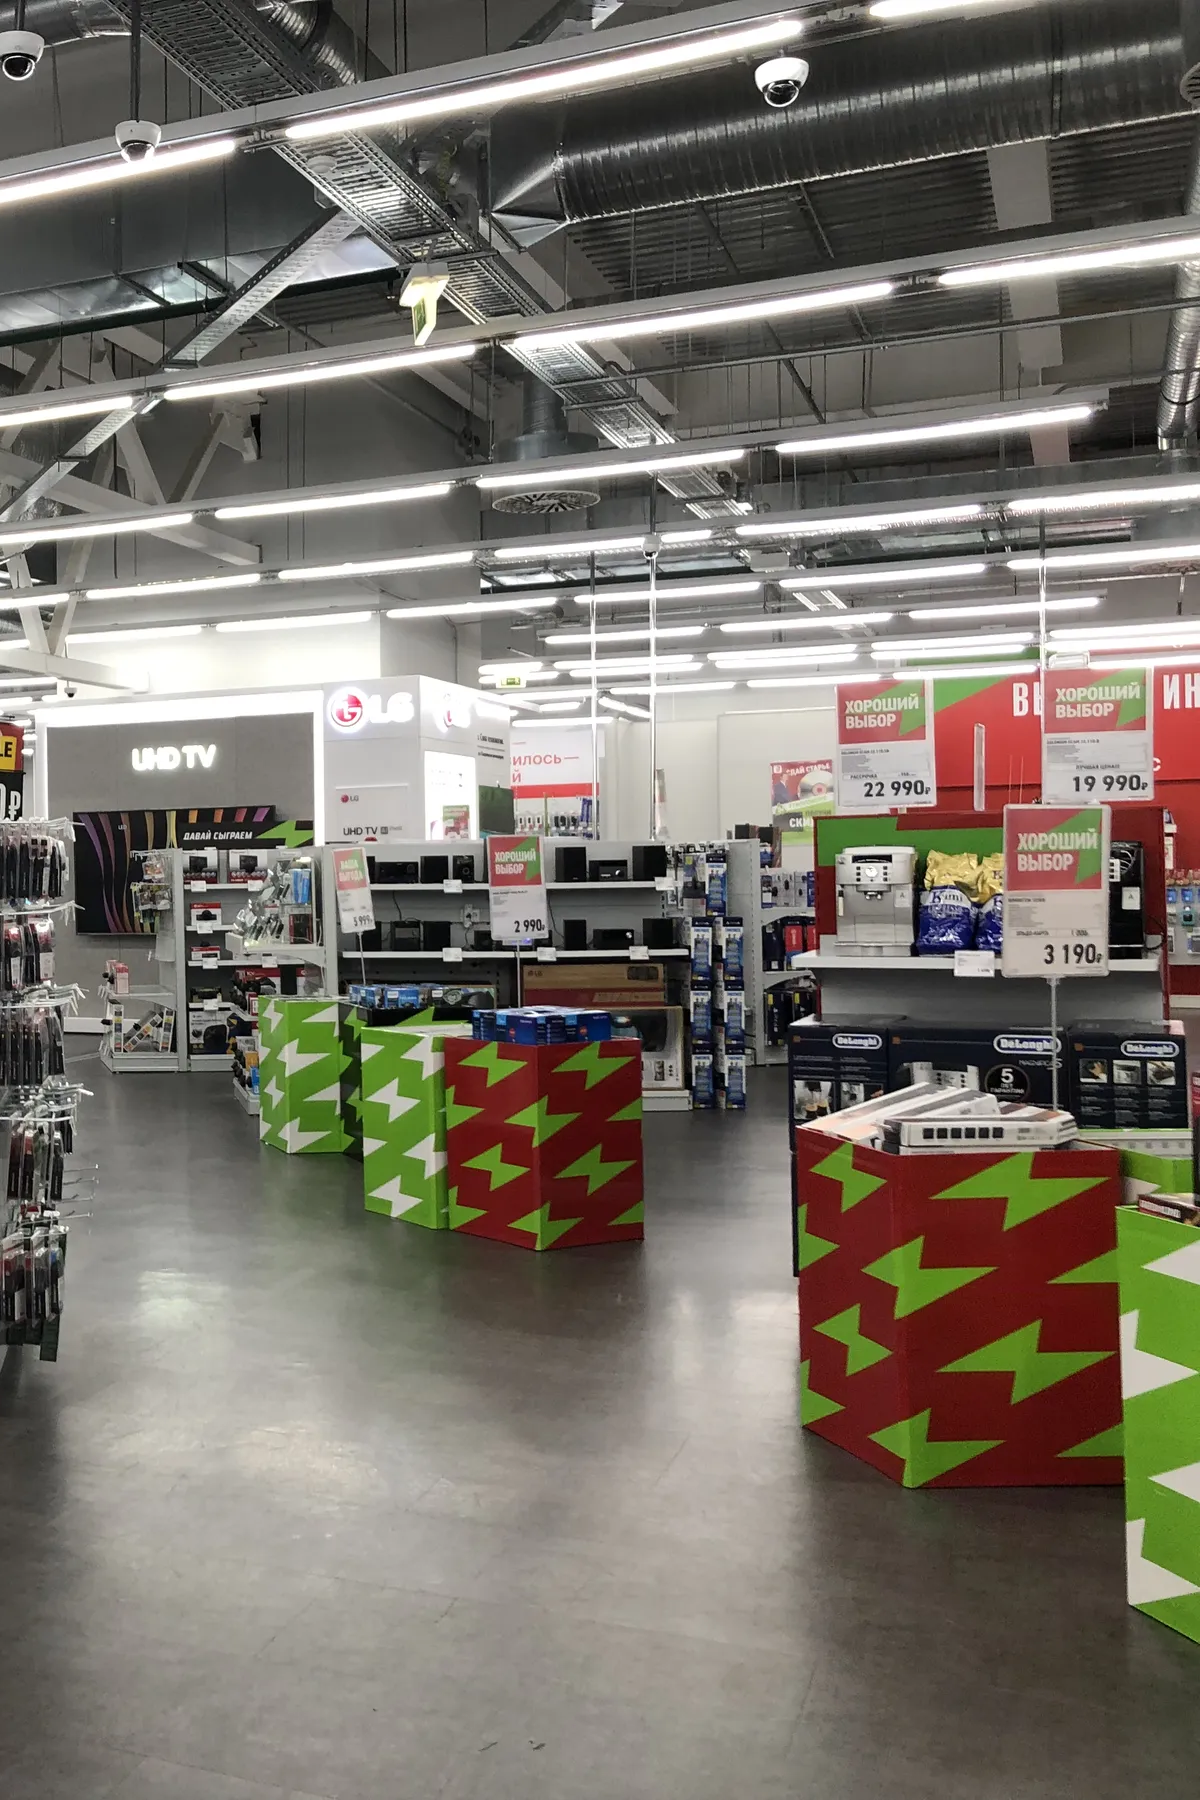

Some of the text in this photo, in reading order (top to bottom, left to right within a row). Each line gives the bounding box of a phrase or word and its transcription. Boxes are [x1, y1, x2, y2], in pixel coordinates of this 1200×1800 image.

[1055, 682, 1140, 702] ХОРОШИЙ
[367, 692, 415, 723] LG
[845, 693, 919, 714] ХОРОШИЙ
[1055, 703, 1114, 718] ВЫБОР
[845, 713, 896, 729] ВЫБОР
[132, 744, 217, 771] UHD TV
[512, 754, 561, 765] ИЛОСЬ
[864, 782, 885, 797] 22
[1073, 776, 1096, 792] 19
[183, 829, 253, 840] ДАВАЙ СЫГРАЕМ
[343, 827, 378, 836] UHD TV
[1017, 828, 1099, 850] ХОРОШИЙ
[494, 848, 537, 862] ХОРОШИЙ
[495, 863, 524, 874] ВЫБОР
[1017, 854, 1074, 872] ВЫБОР
[514, 920, 520, 933] 2
[1044, 944, 1054, 964] 3
[1000, 1038, 1055, 1052] DeLongh
[1001, 1068, 1014, 1083] 5
